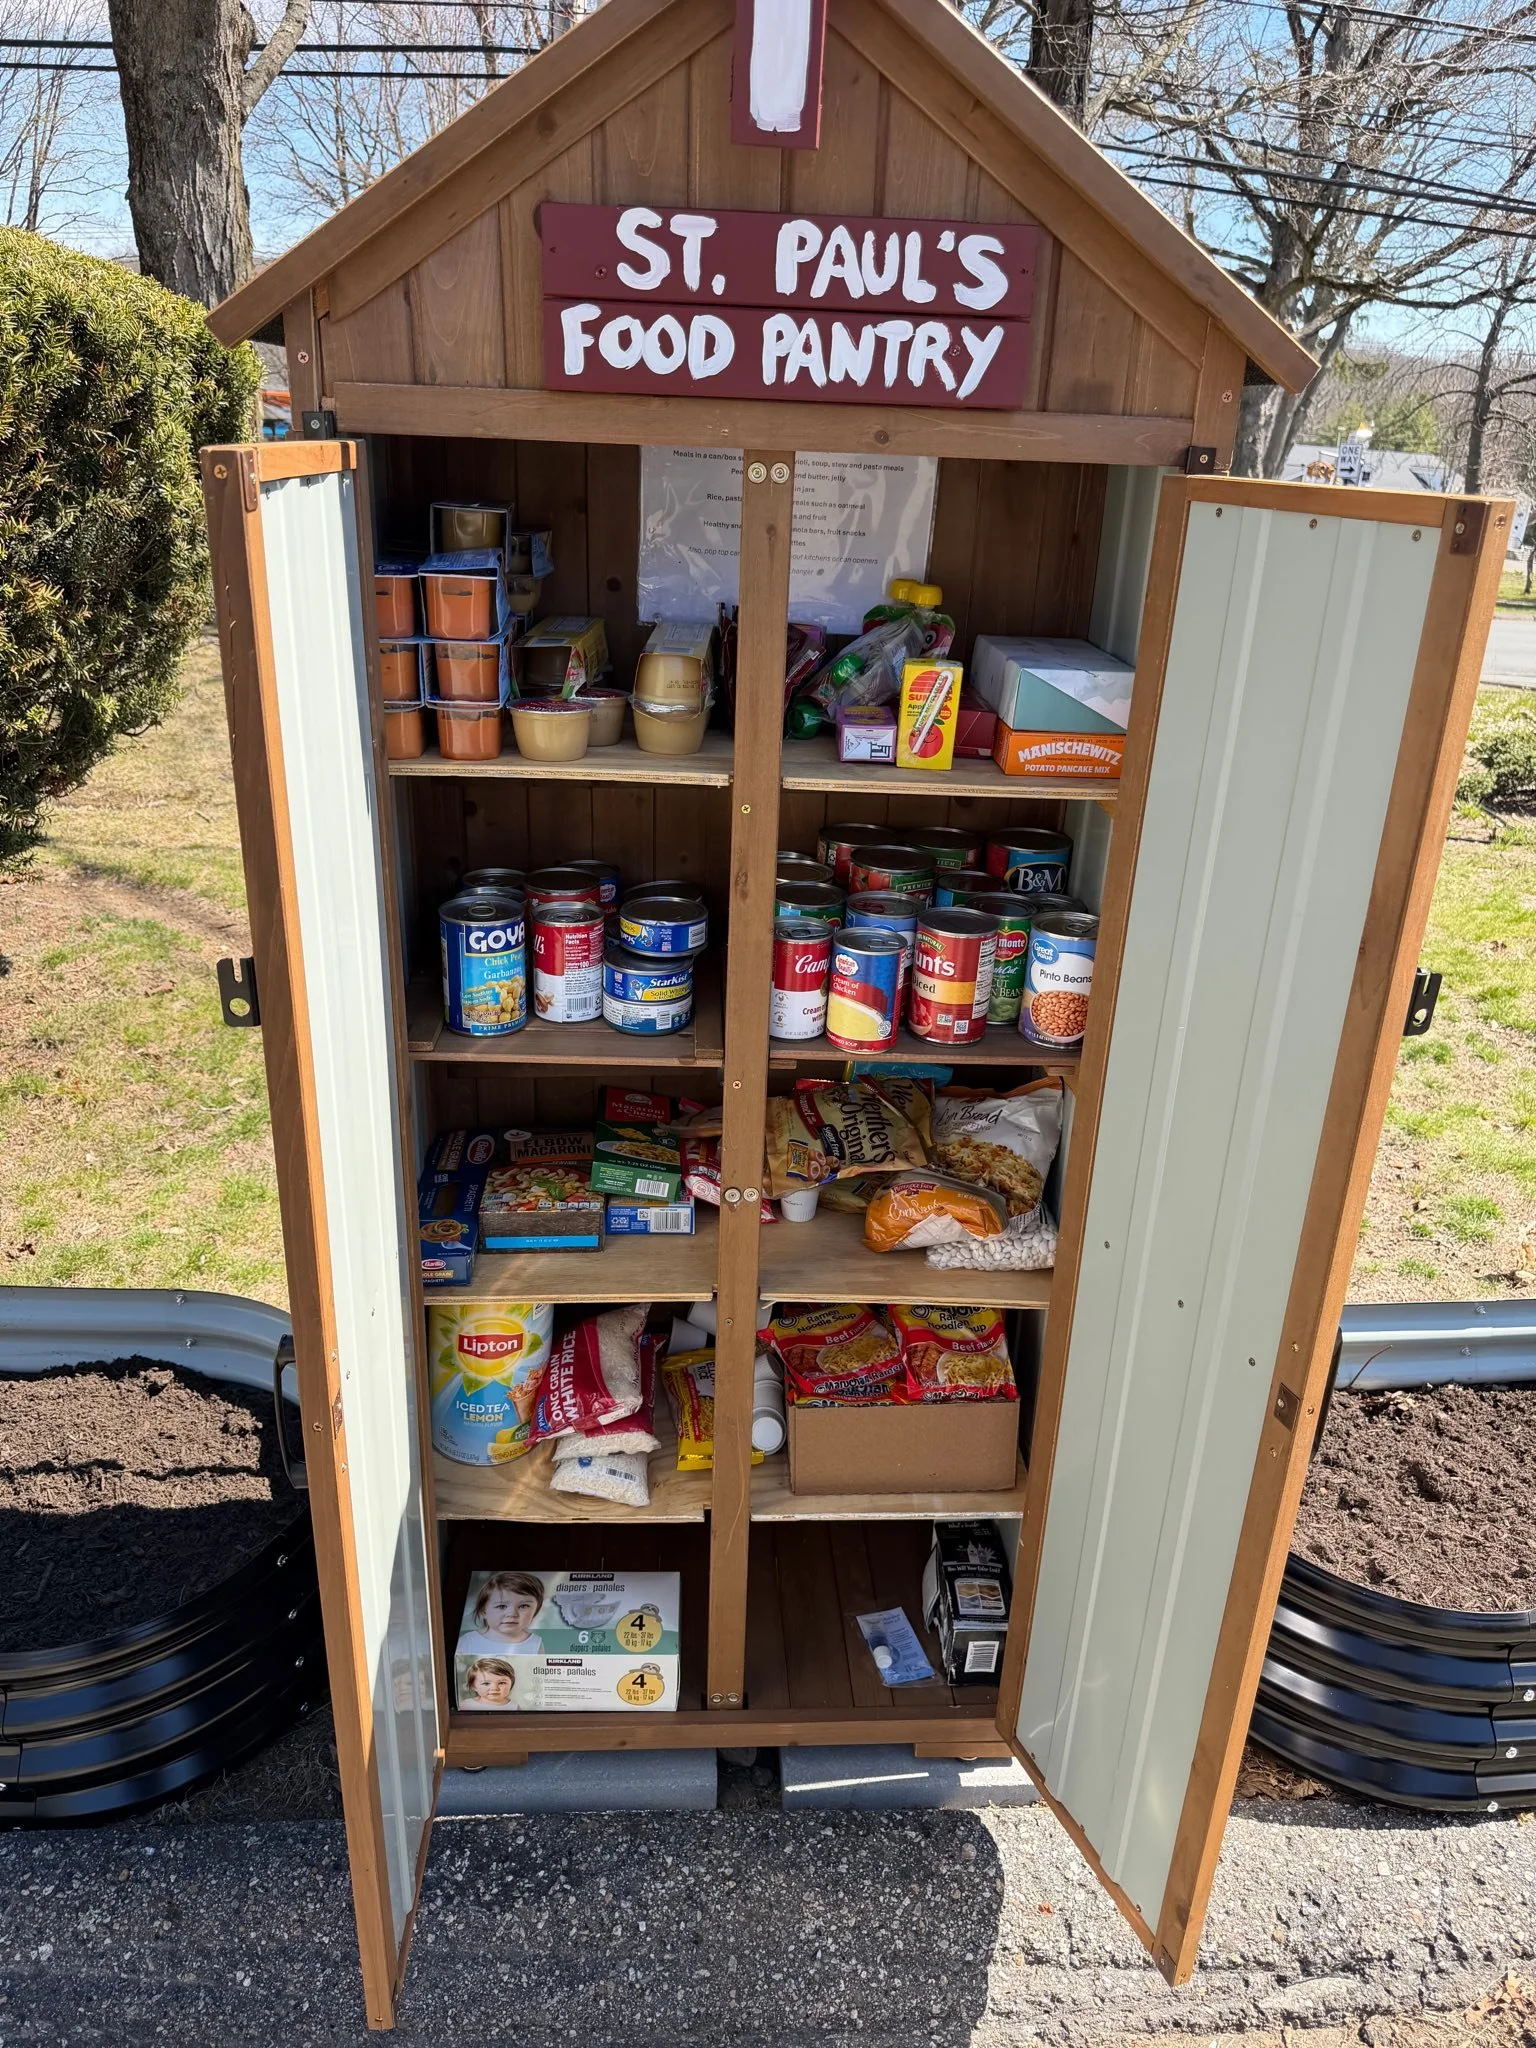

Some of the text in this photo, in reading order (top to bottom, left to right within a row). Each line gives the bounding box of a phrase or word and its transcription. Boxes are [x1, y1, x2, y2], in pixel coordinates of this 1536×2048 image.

[616, 207, 1009, 310] ST. PAUL'S
[560, 303, 1004, 400] FOOD PANTRY
[673, 450, 694, 459] Meals
[708, 453, 737, 461] can/box
[1341, 446, 1360, 455] ONE
[811, 460, 830, 468] soup,
[862, 463, 883, 471] pasta
[1340, 456, 1359, 465] WAY
[831, 475, 847, 483] jelly
[706, 493, 724, 501] Rice,
[837, 502, 866, 510] oatmeal
[703, 520, 730, 529] Healthy
[842, 529, 866, 537] snacks
[1017, 741, 1123, 766] MANISCHEWITZ
[1024, 764, 1111, 774] POTATO PANCAKE MIX
[1017, 866, 1065, 894] B&M
[468, 921, 525, 952] GOYA
[998, 938, 1026, 948] Monte
[1034, 942, 1054, 957] Great
[1037, 951, 1053, 962] Value
[484, 956, 508, 967] Chick
[649, 973, 688, 987] StarKist
[833, 974, 859, 990] Cream of
[1040, 968, 1092, 984] Pinto Beans
[650, 989, 668, 997] Solid
[833, 983, 857, 997] Chicken
[611, 1101, 666, 1116] Macaroni
[623, 1107, 665, 1120] Cheese
[959, 1104, 1003, 1126] Bread
[523, 1136, 583, 1148] ELBOW
[823, 1126, 841, 1157] Sugar Free
[517, 1143, 591, 1158] MACARONI
[464, 1184, 478, 1212] SPAGHETTI
[797, 1311, 857, 1334] Noodle Soup
[807, 1309, 840, 1324] Ramen
[825, 1321, 867, 1345] Beef Flavor
[463, 1337, 518, 1355] Lipton
[952, 1337, 995, 1352] Beef Flavor
[549, 1353, 561, 1388] GRAIN
[560, 1330, 580, 1422] WHITE RICE
[871, 1362, 904, 1381] Ramen
[456, 1401, 511, 1413] ICED TEA
[463, 1412, 504, 1422] LEMON
[556, 1583, 626, 1593] diapers pañales
[630, 1614, 646, 1632] 4
[578, 1630, 589, 1645] 6
[631, 1639, 638, 1648] kg
[646, 1639, 652, 1648] kg
[569, 1643, 612, 1653] diapers pañales
[532, 1666, 597, 1677] diapers pañales
[631, 1673, 647, 1689] 4
[633, 1694, 640, 1702] kg
[647, 1694, 654, 1702] kg
